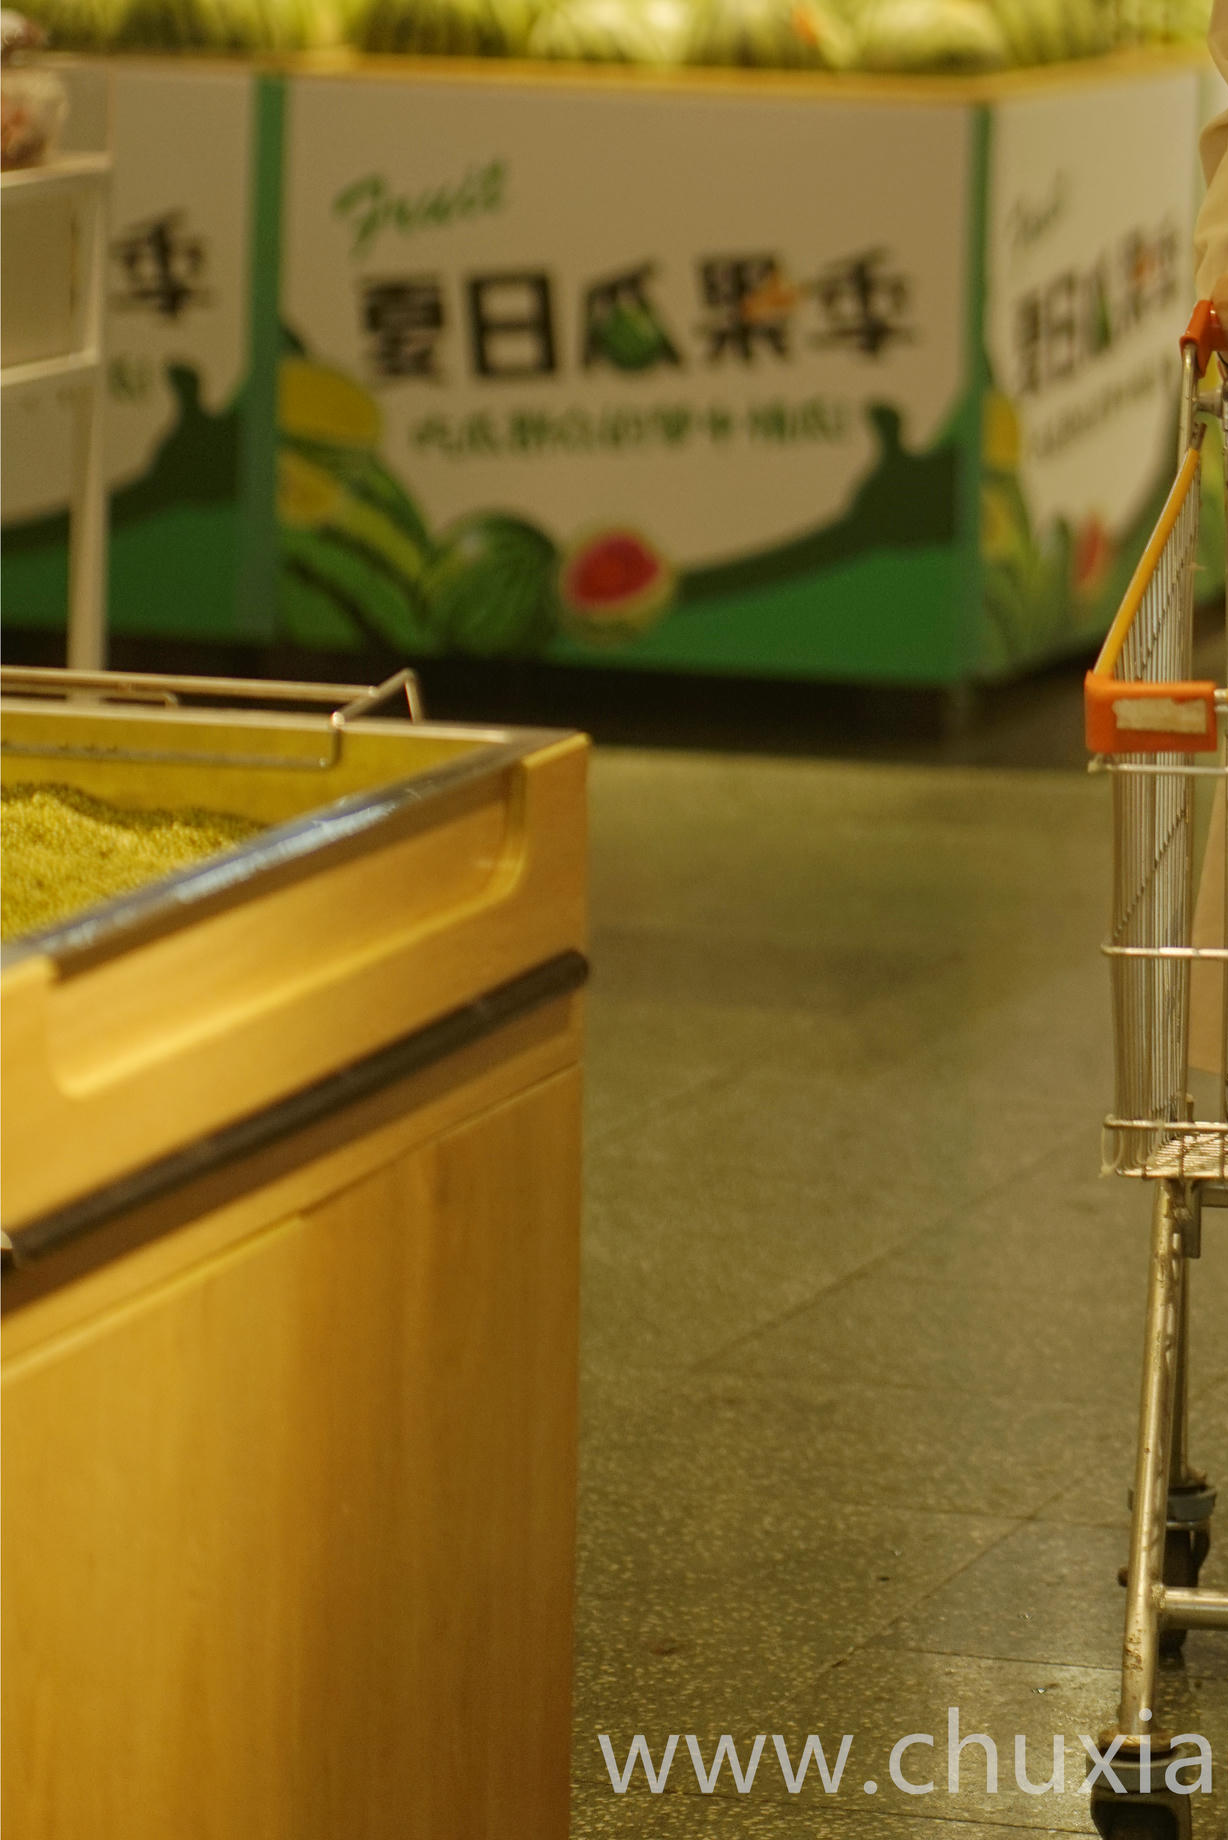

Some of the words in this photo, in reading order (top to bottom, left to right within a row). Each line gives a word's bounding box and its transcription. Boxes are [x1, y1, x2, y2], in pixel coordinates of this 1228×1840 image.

[360, 250, 915, 382] 夏日瓜果季
